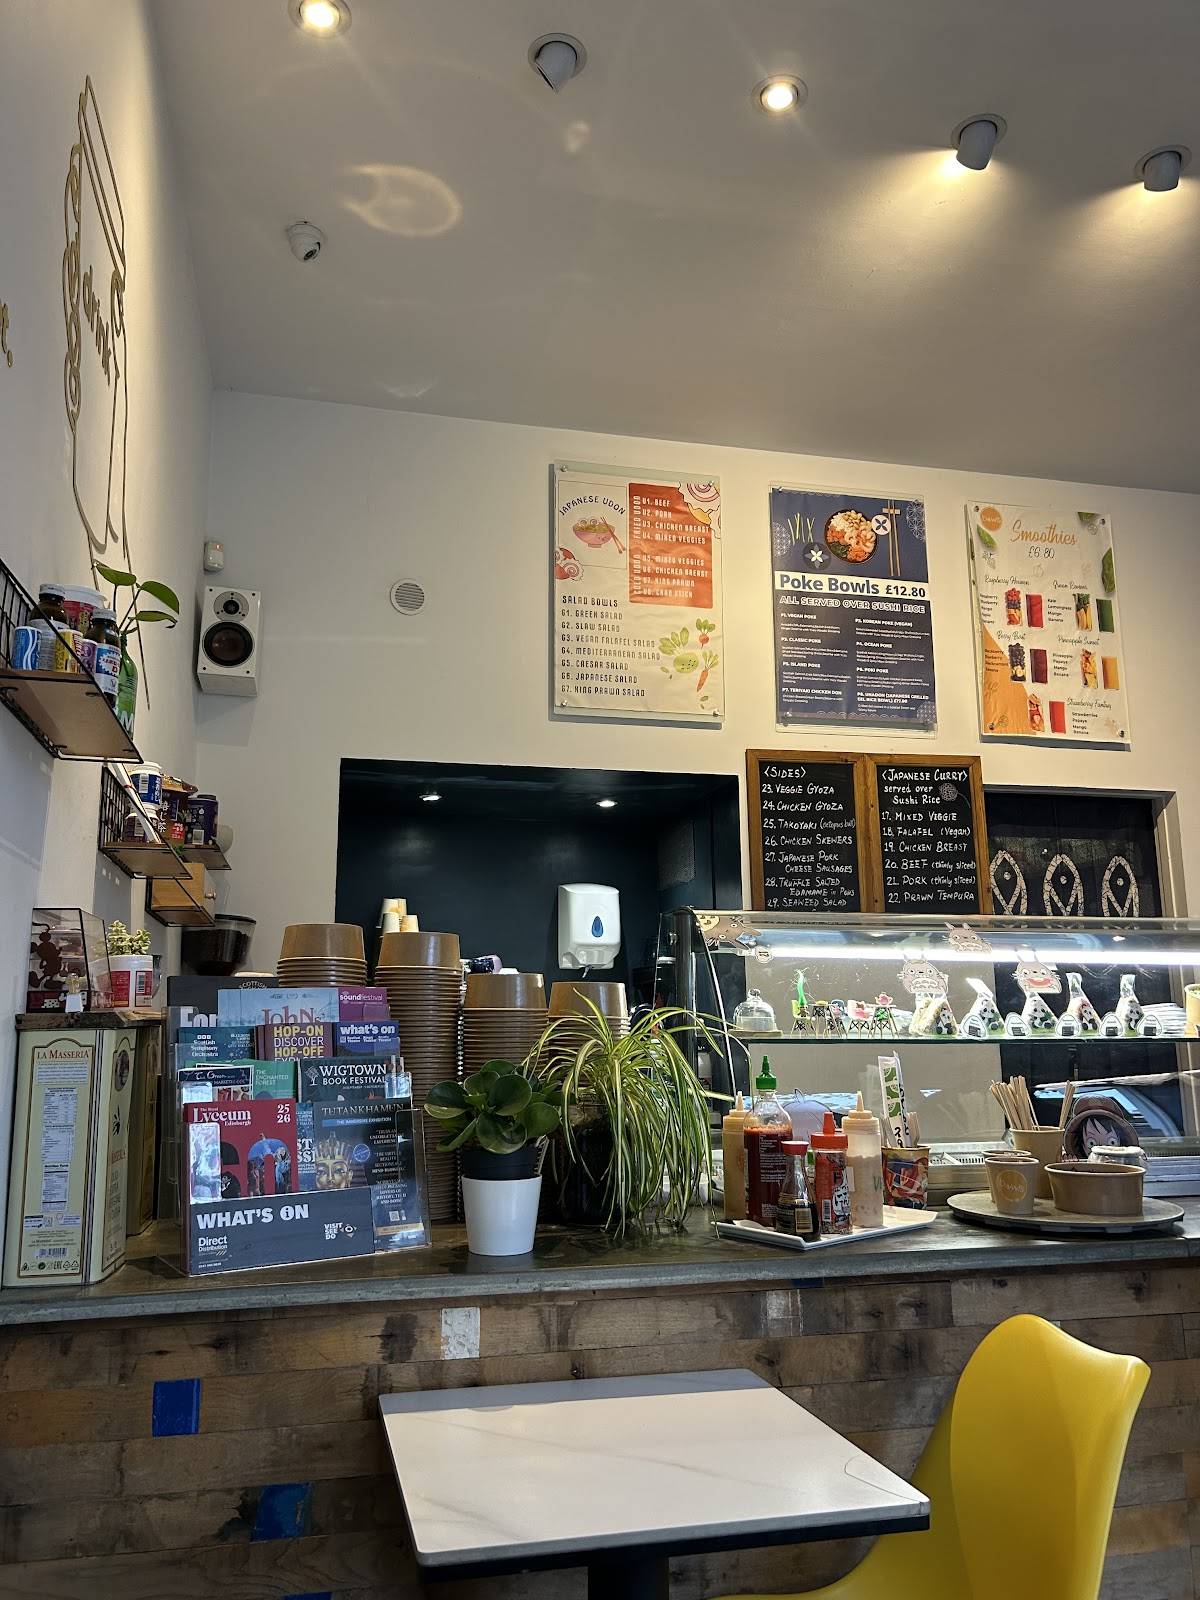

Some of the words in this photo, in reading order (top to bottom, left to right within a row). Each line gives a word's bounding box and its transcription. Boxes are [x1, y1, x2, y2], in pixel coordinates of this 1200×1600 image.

[559, 495, 599, 516] JAPANESE
[602, 497, 626, 515] UDON
[655, 499, 671, 507] BEEF
[655, 510, 672, 519] PORK
[633, 517, 641, 539] FRIED
[655, 522, 682, 531] CHICKEN
[684, 525, 710, 534] BREAST
[1010, 519, 1077, 546] Smoothies
[655, 533, 677, 542] MIXED
[678, 535, 706, 544] VEGGIES
[1028, 545, 1056, 559] £6.80
[780, 574, 823, 591] Poke
[828, 577, 879, 595] Bowls
[885, 584, 926, 598] £12.80
[562, 595, 588, 606] SALAD
[591, 597, 618, 608] BOWLS
[779, 595, 800, 605] ALL
[800, 596, 840, 607] SERVED
[842, 599, 870, 610] OVER
[871, 602, 901, 612] SUSHI
[902, 604, 926, 614] RICE
[575, 609, 598, 619] GREEN
[600, 611, 623, 621] SALAD
[575, 622, 596, 631] SLAW
[598, 623, 620, 633] SALAD
[575, 634, 599, 644] VEGAN
[601, 636, 631, 647] FALAFEL
[633, 639, 656, 648] SALAD
[575, 647, 636, 660] MEDITERRANEAN
[638, 651, 661, 661] SALAD
[575, 659, 604, 669] CAESAR
[606, 661, 629, 671] SALAD
[575, 672, 613, 682] JAPANESE
[614, 674, 638, 684] SALAD
[574, 685, 592, 695] KING
[594, 686, 620, 696] PRAWN
[622, 688, 645, 697] SALAD
[762, 783, 773, 794] 23.
[775, 783, 803, 794] VEGGIE
[806, 783, 835, 795] GYOZA
[883, 783, 911, 793] served
[915, 785, 933, 793] over
[892, 794, 918, 805] Sushi
[921, 794, 941, 805] Rice
[762, 800, 776, 811] 24.
[776, 800, 812, 812] CHICKEN
[815, 801, 844, 811] GYOZA
[881, 810, 892, 821] 17.
[895, 811, 924, 821] MIXED
[763, 818, 776, 829] 25.
[778, 818, 817, 830] TAKOYAKI
[882, 826, 894, 837] 18.
[897, 826, 933, 837] FALAFEL
[940, 826, 971, 838] (Vegan)
[764, 835, 778, 846] 26.
[780, 835, 813, 846] CHICKEN
[815, 833, 853, 845] SKEWERS
[883, 841, 896, 852] 19.
[898, 841, 932, 852] CHICKEN
[935, 840, 968, 853] BREAST
[764, 851, 776, 862] 27.
[778, 851, 815, 863] JAPANESE
[818, 850, 840, 862] PORK
[785, 864, 812, 873] CHEESE
[815, 862, 853, 873] SAUSAGES
[884, 858, 899, 869] 20.
[900, 858, 928, 870] BEEF
[931, 860, 953, 872] (thinly
[955, 860, 977, 870] sliced)
[764, 877, 778, 888] 28.
[778, 876, 811, 888] TRUFFLE
[815, 876, 841, 888] SALTED
[886, 876, 899, 886] 21.
[902, 875, 928, 885] PORK
[930, 875, 952, 887] (thinly
[953, 875, 976, 885] sliced)
[789, 887, 829, 897] EDAMAME
[887, 892, 901, 903] 22.
[903, 891, 934, 902] PRAWN
[937, 889, 975, 901] TEMPURA
[767, 898, 779, 909] 29.
[781, 897, 819, 907] SEAWEED
[822, 897, 847, 907] SALAD
[273, 1025, 324, 1038] HOP-ON
[340, 1024, 379, 1035] what's
[380, 1025, 396, 1034] on
[273, 1036, 324, 1047] DISCOVER
[37, 1050, 47, 1059] LA
[49, 1049, 89, 1059] MASSERIA
[274, 1046, 324, 1058] HOP-OFF
[319, 1064, 387, 1077] WIGTOWN
[322, 1077, 347, 1086] BOOK
[350, 1076, 387, 1085] FESTIVAL
[193, 1107, 252, 1123] Lyceum
[277, 1104, 290, 1114] 25
[321, 1103, 404, 1116] TUTANKHAMUN
[277, 1114, 291, 1123] 26
[197, 1207, 274, 1230] WHAT'S
[280, 1203, 309, 1221] ON
[324, 1222, 343, 1230] VISIT
[198, 1235, 228, 1247] Direct
[198, 1244, 228, 1252] Distribution
